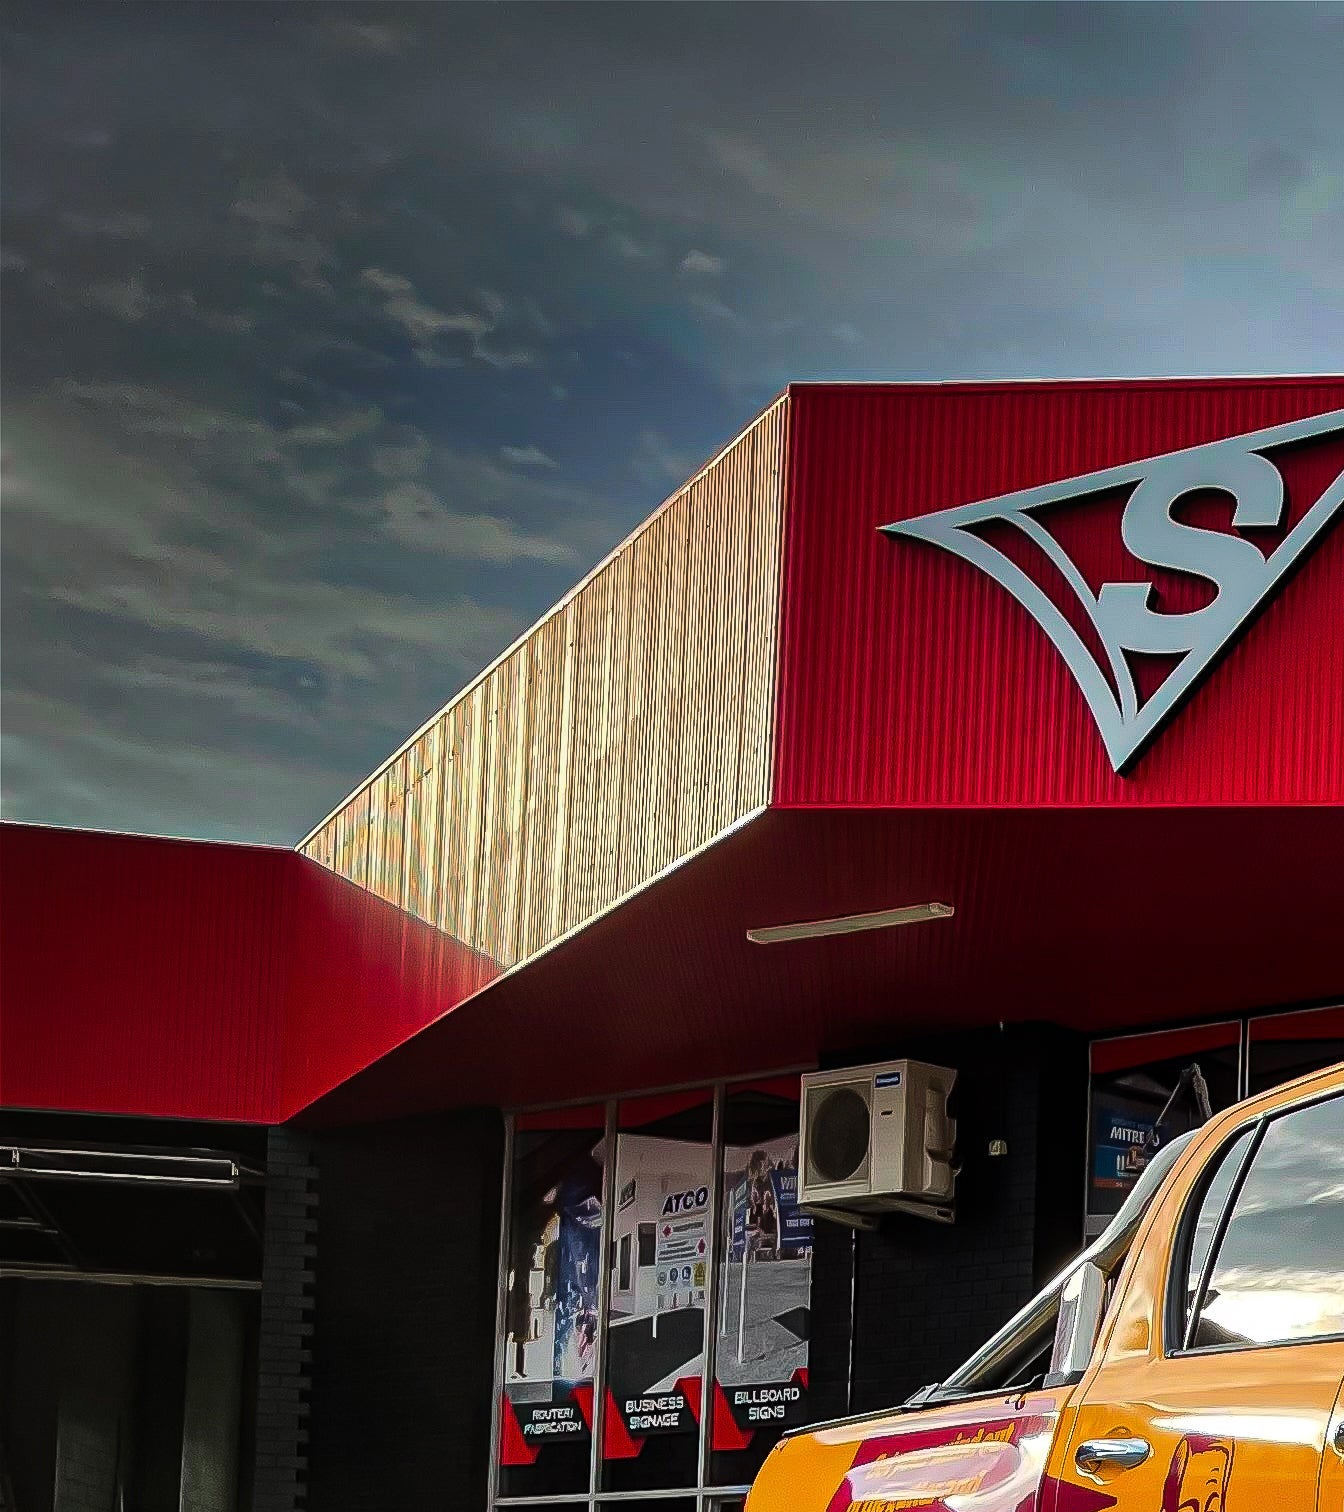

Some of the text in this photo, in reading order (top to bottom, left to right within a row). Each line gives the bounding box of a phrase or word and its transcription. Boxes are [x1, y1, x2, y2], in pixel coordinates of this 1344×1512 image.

[662, 1186, 709, 1216] ATCO
[625, 1396, 684, 1412] BUSINESS
[734, 1387, 800, 1405] BILLBOARD
[629, 1412, 680, 1430] SIGNAGE
[748, 1405, 785, 1420] SIGNS
